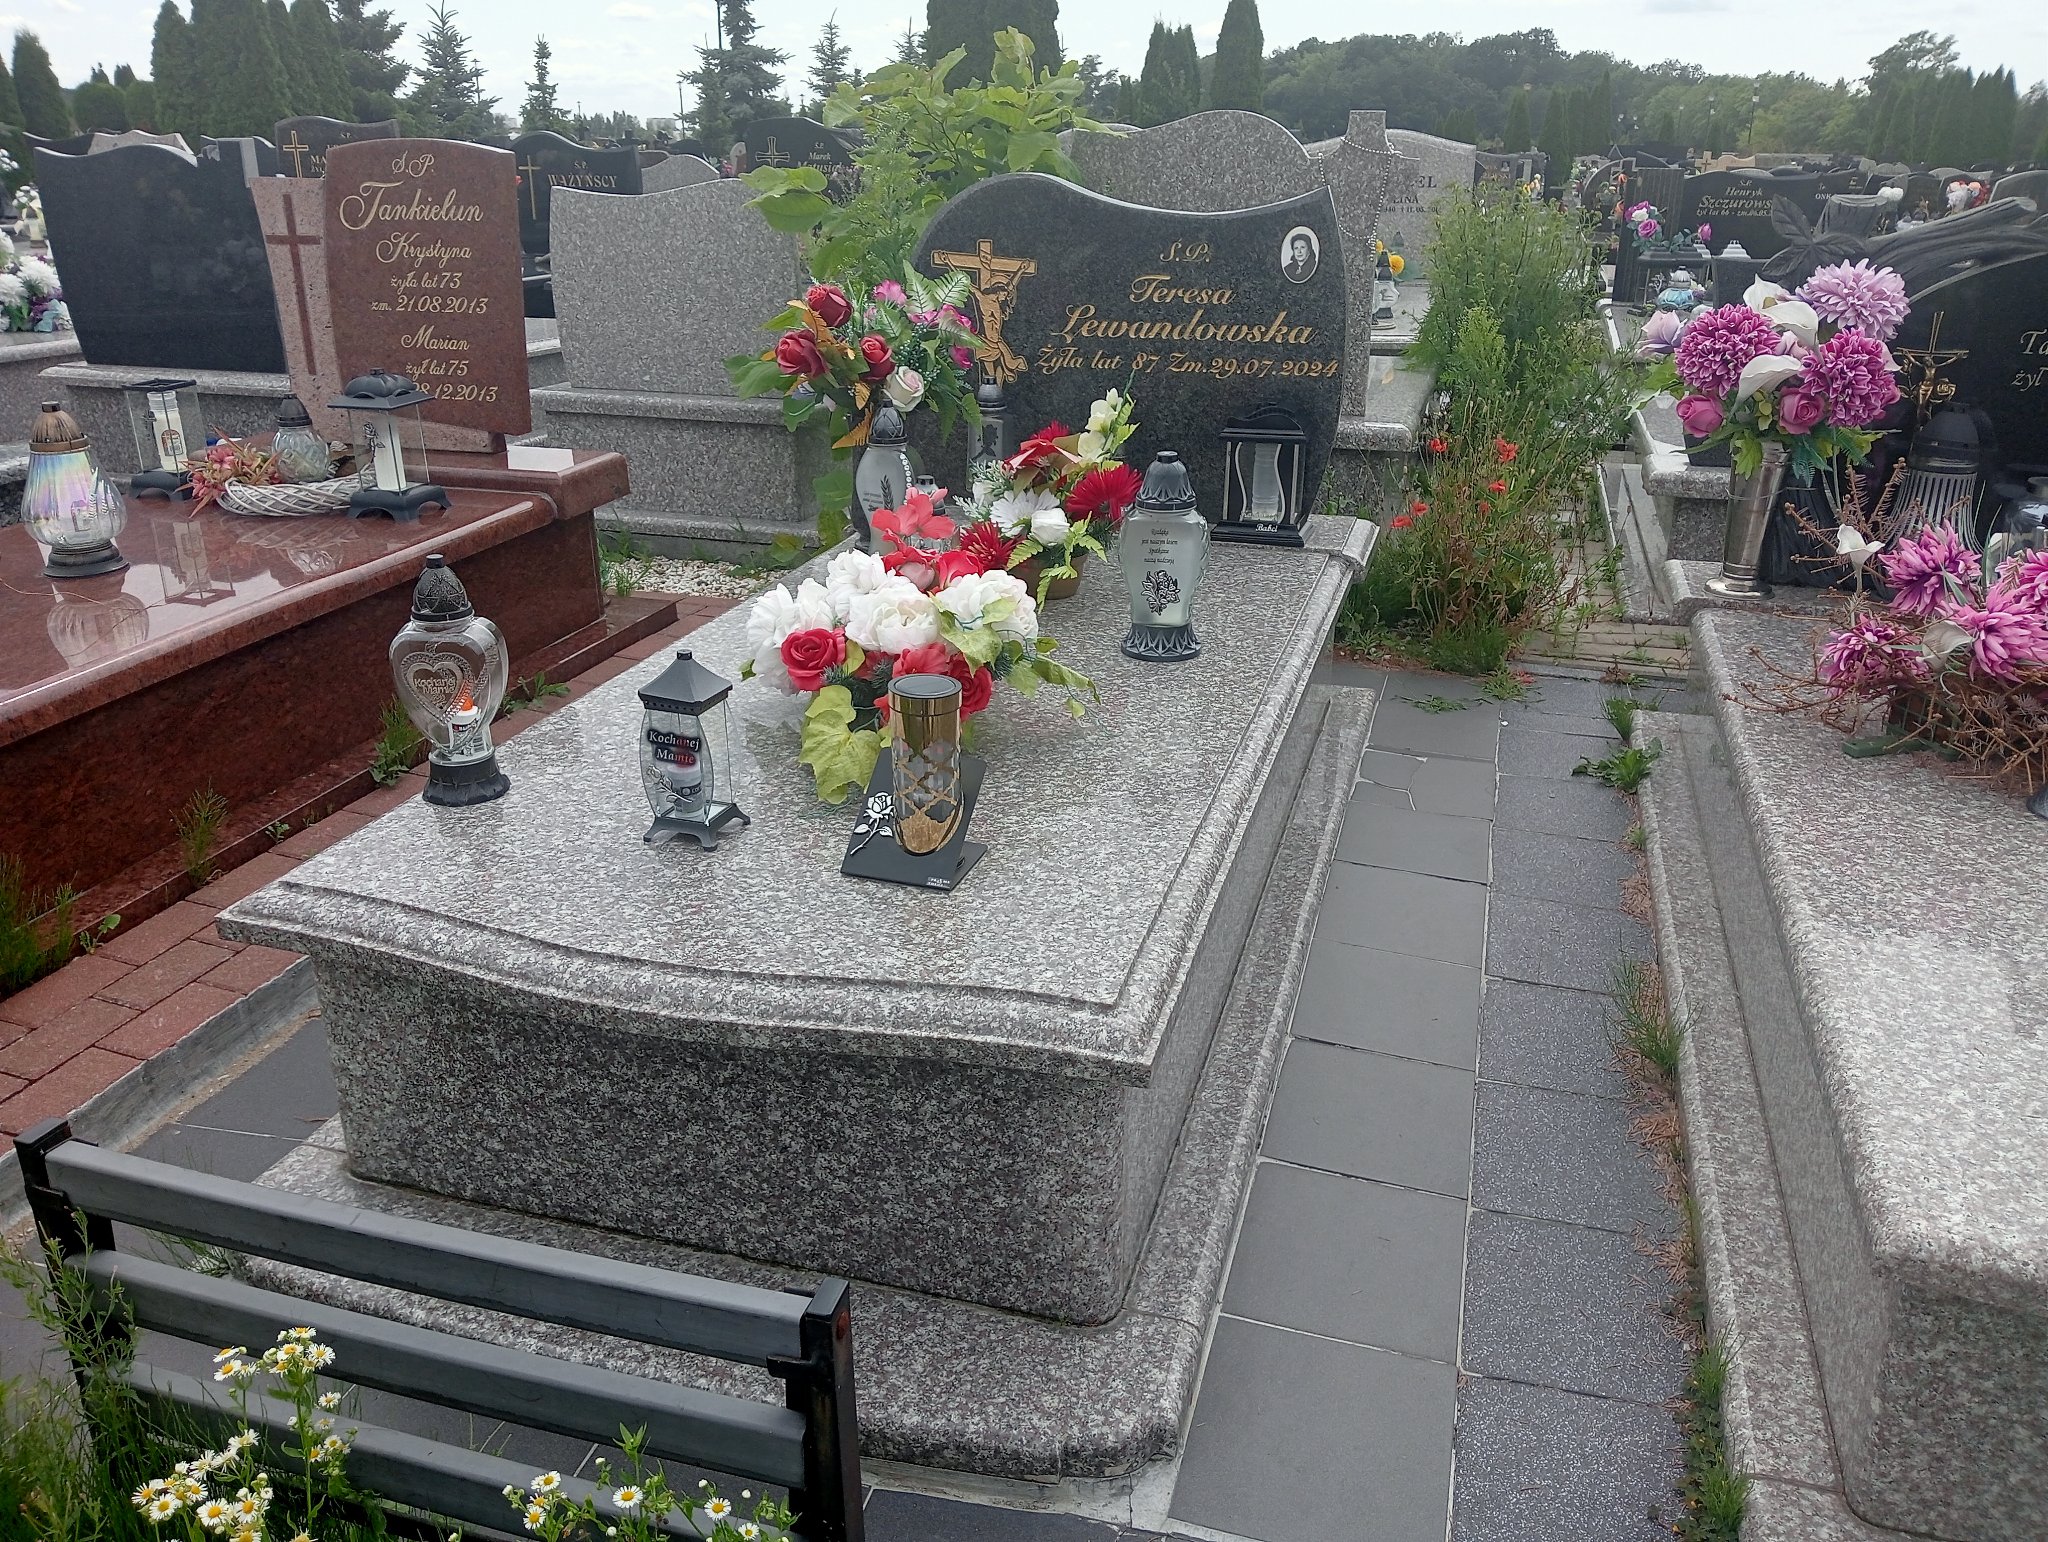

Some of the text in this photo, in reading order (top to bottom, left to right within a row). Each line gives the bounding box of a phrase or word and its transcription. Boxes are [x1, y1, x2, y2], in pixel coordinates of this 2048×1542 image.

[808, 152, 831, 160] Marek
[1698, 195, 1773, 208] Szczurows
[1725, 186, 1763, 198] Henryk
[340, 181, 484, 230] Tankielun
[376, 232, 472, 268] Krystyna
[390, 271, 463, 295] żyła lat 73
[1129, 274, 1236, 305] Teresa
[396, 295, 489, 314] 21.08.2013
[1050, 304, 1317, 345] Lewandowska
[401, 324, 470, 350] Marian
[2020, 328, 2048, 355] Ta
[405, 358, 469, 380] żył lat 75
[1034, 344, 1084, 375] Żyła
[1090, 350, 1124, 370] lat
[1132, 352, 1161, 373] 87
[414, 382, 498, 402] 812.2013
[649, 731, 700, 751] Kochanej
[656, 748, 694, 764] Mamie
